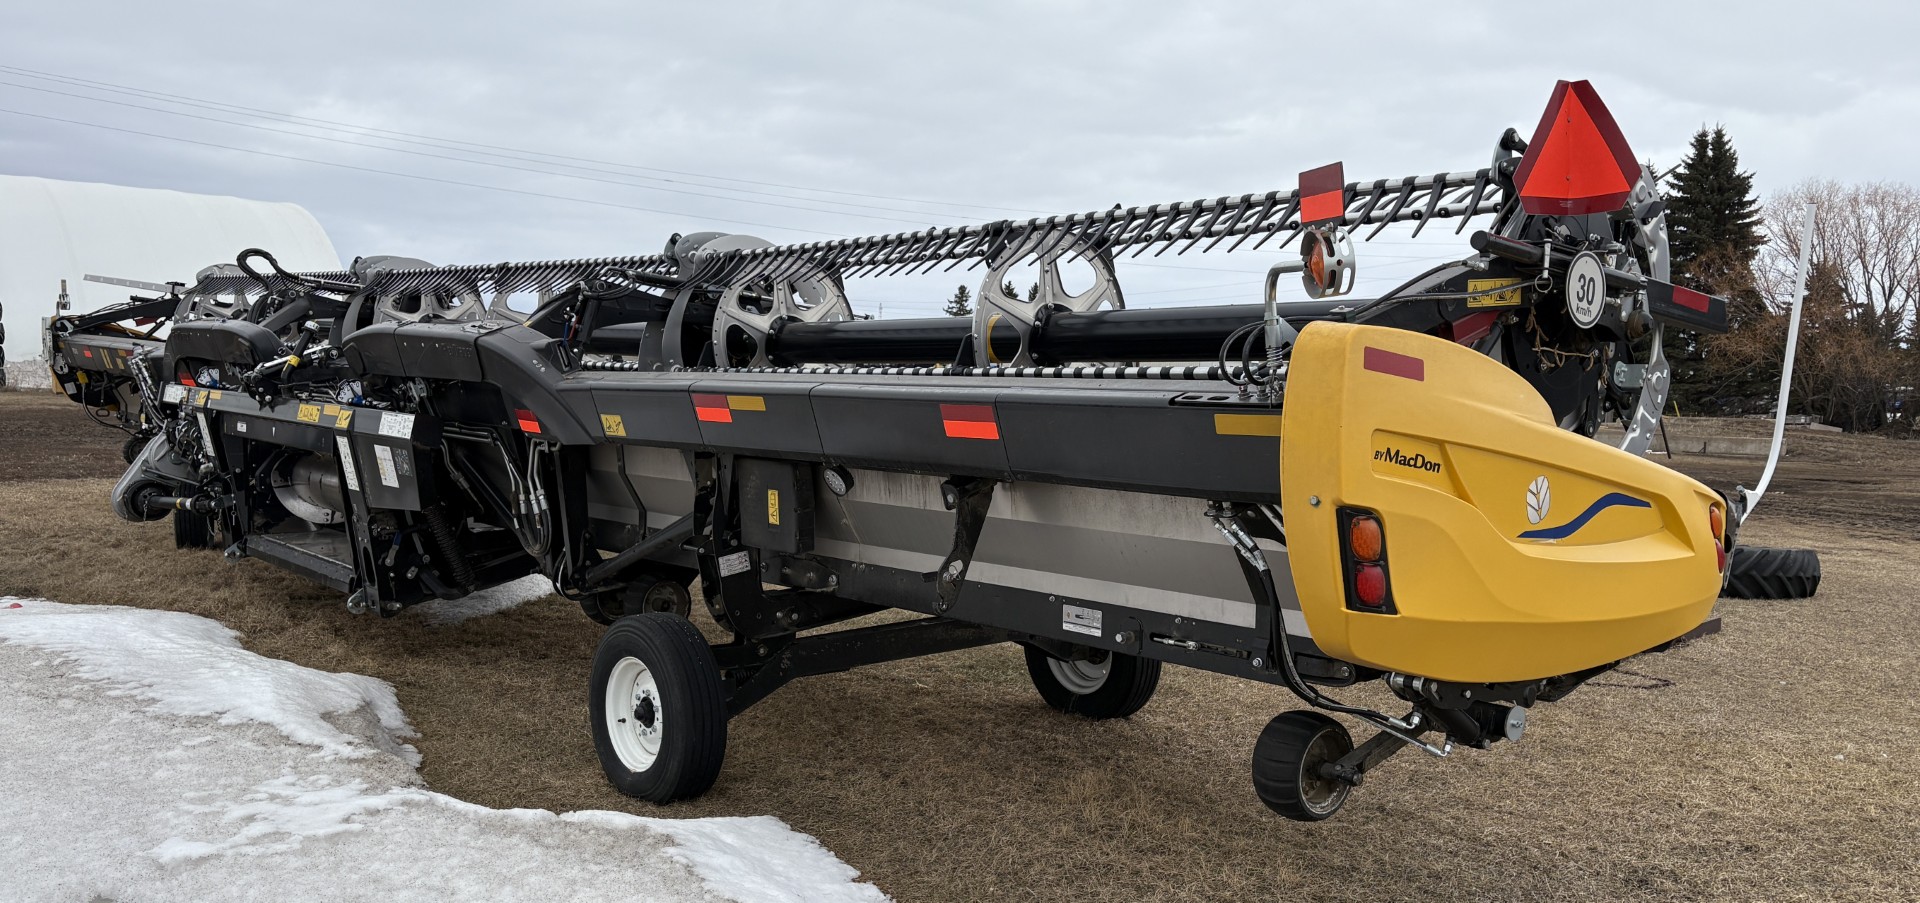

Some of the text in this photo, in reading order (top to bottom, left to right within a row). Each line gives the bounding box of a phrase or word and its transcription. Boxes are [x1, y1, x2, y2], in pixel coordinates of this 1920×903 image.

[1576, 273, 1596, 306] 30
[1576, 303, 1592, 318] km/h
[1373, 446, 1441, 474] BY MacDon
